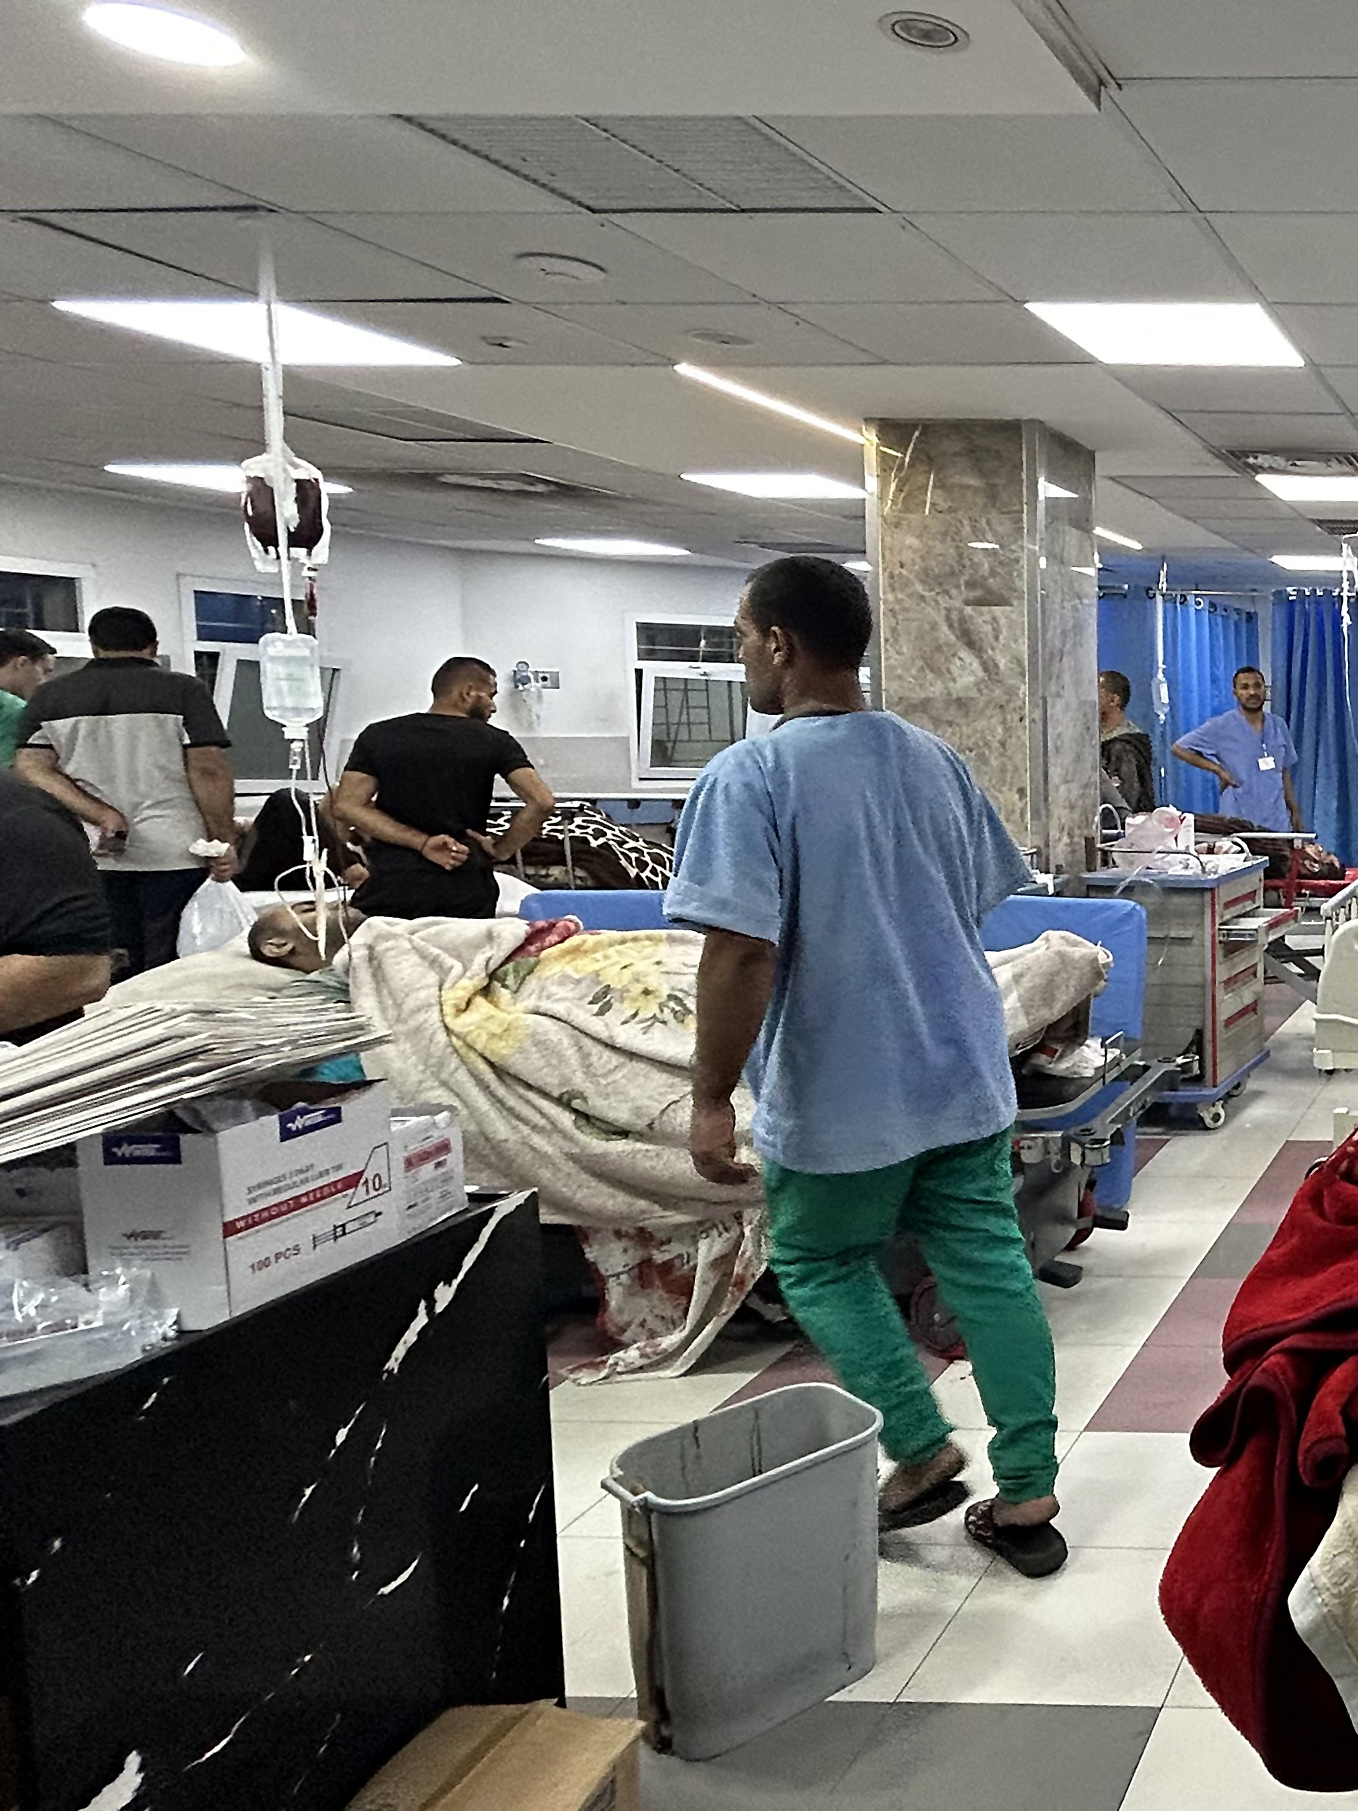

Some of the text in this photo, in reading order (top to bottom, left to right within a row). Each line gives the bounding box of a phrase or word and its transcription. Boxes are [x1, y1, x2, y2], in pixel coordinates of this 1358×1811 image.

[361, 1172, 383, 1196] 10
[235, 1182, 342, 1229] WITHOUT NEEDLE
[249, 1243, 302, 1275] 100 PCS
